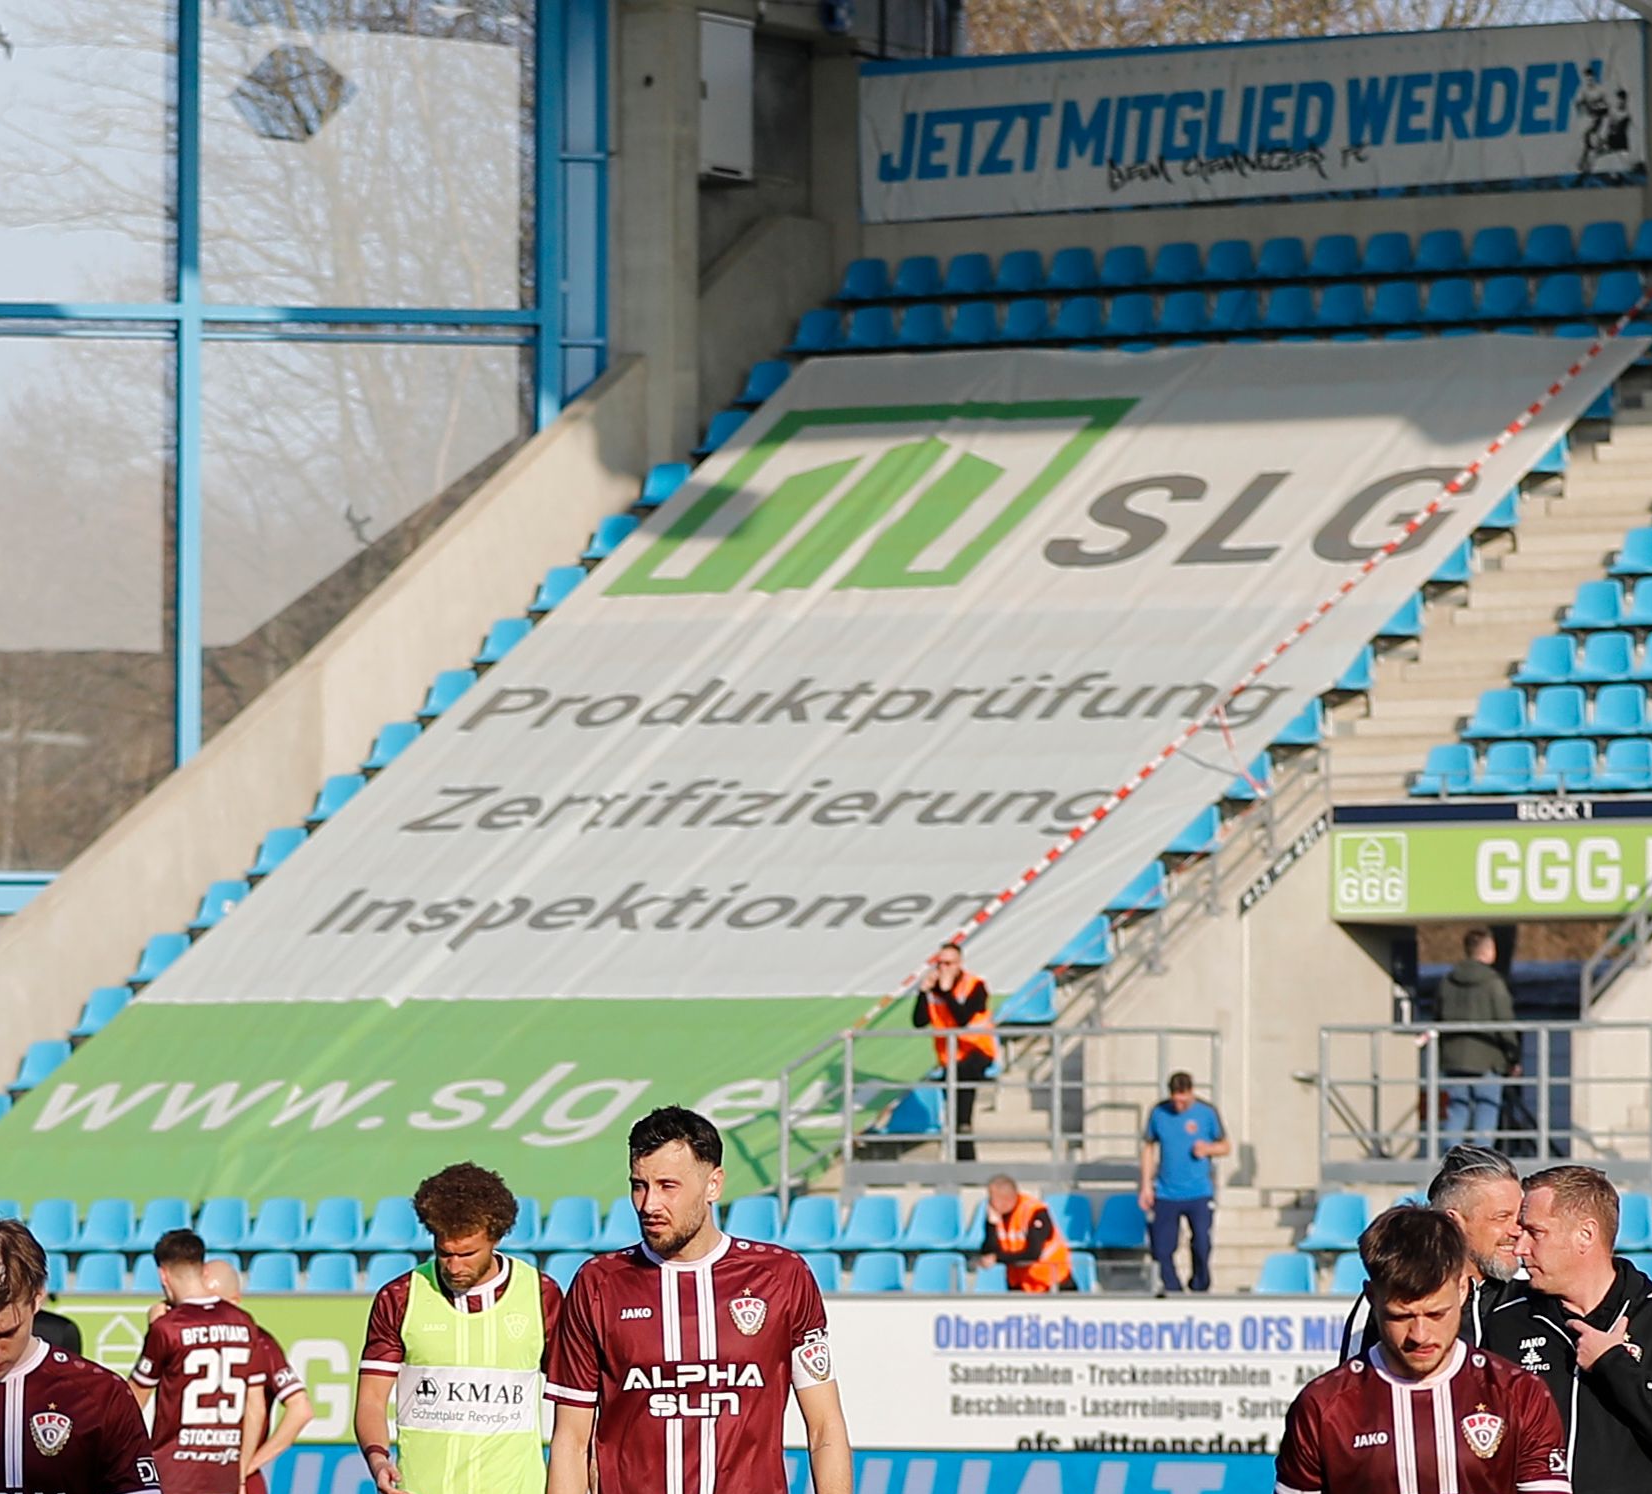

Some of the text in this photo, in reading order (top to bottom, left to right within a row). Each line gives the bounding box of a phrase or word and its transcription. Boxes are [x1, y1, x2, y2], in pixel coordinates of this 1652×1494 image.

[878, 59, 1604, 183] JETZT MITGLIED WERDEN
[1042, 465, 1476, 569] SLG
[459, 669, 1293, 736] Produktprüfung
[1517, 801, 1581, 822] BLOCK
[1339, 877, 1403, 904] GGG
[620, 1307, 652, 1320] JAKO
[181, 1327, 209, 1346] BFC
[934, 1314, 1231, 1351] Oberflächenservice
[1240, 1315, 1293, 1351] OFS
[1519, 1336, 1547, 1350] JAKO
[181, 1346, 251, 1426] 25
[623, 1363, 764, 1391] ALPHA
[950, 1364, 1073, 1387] Sandstrahlen
[1088, 1364, 1271, 1388] Trockeneisstrahlen
[447, 1382, 524, 1405] KMAB
[648, 1392, 741, 1417] SUN
[950, 1395, 1066, 1418] Beschichten
[1081, 1396, 1223, 1421] Laserreinigung
[36, 1415, 67, 1427] BFC
[1466, 1416, 1499, 1429] BFC
[1353, 1431, 1388, 1448] JAKO
